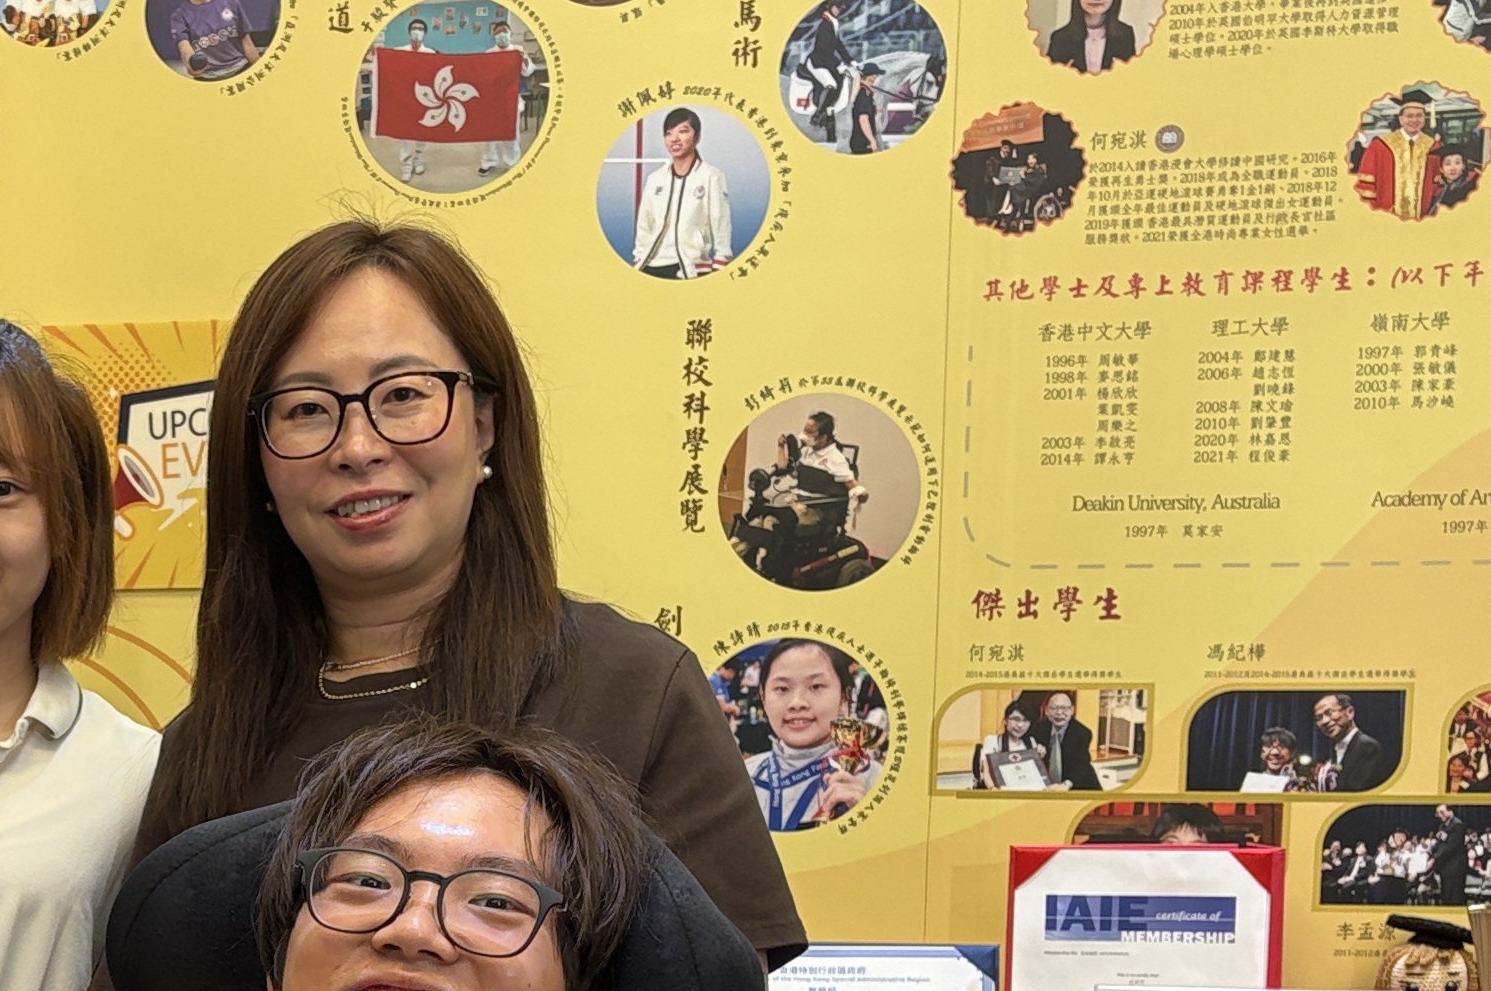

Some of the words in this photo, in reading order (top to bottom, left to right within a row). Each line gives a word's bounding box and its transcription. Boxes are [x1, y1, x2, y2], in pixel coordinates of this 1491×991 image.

[731, 0, 763, 69] 馬術
[1211, 316, 1290, 338] 理工大學
[1369, 310, 1451, 333] 嶺南大學
[1038, 321, 1152, 342] 香港中文大學
[1197, 350, 1243, 364] 2004年
[1358, 345, 1404, 360] 1997年
[1045, 354, 1088, 367] 1996年
[1197, 366, 1243, 381] 2006年
[1355, 362, 1404, 377] 2000年
[1045, 370, 1087, 384] 1998年
[1354, 378, 1403, 393] 2003年
[1043, 387, 1087, 400] 2001年
[1195, 400, 1241, 414] 2008年
[1353, 396, 1401, 410] 2010年
[678, 318, 714, 533] 聯校科學展覽
[1194, 416, 1240, 430] 2010年
[1041, 436, 1086, 450] 2003年
[1193, 433, 1239, 447] 2020年
[1040, 452, 1085, 466] 2014年
[1193, 449, 1239, 463] 2021年
[1072, 495, 1125, 512] Deakin
[1128, 493, 1208, 514] University,
[1210, 492, 1281, 510] Australia
[1370, 489, 1449, 511] Academy
[1450, 488, 1469, 507] of
[1124, 525, 1169, 538] 1997年
[1442, 519, 1489, 534] 1997年
[971, 585, 1122, 622] 傑出學生
[1045, 895, 1149, 931] IAIE
[1155, 910, 1208, 923] certificate
[1209, 909, 1223, 922] of
[1120, 931, 1236, 944] MEMBERSHIP
